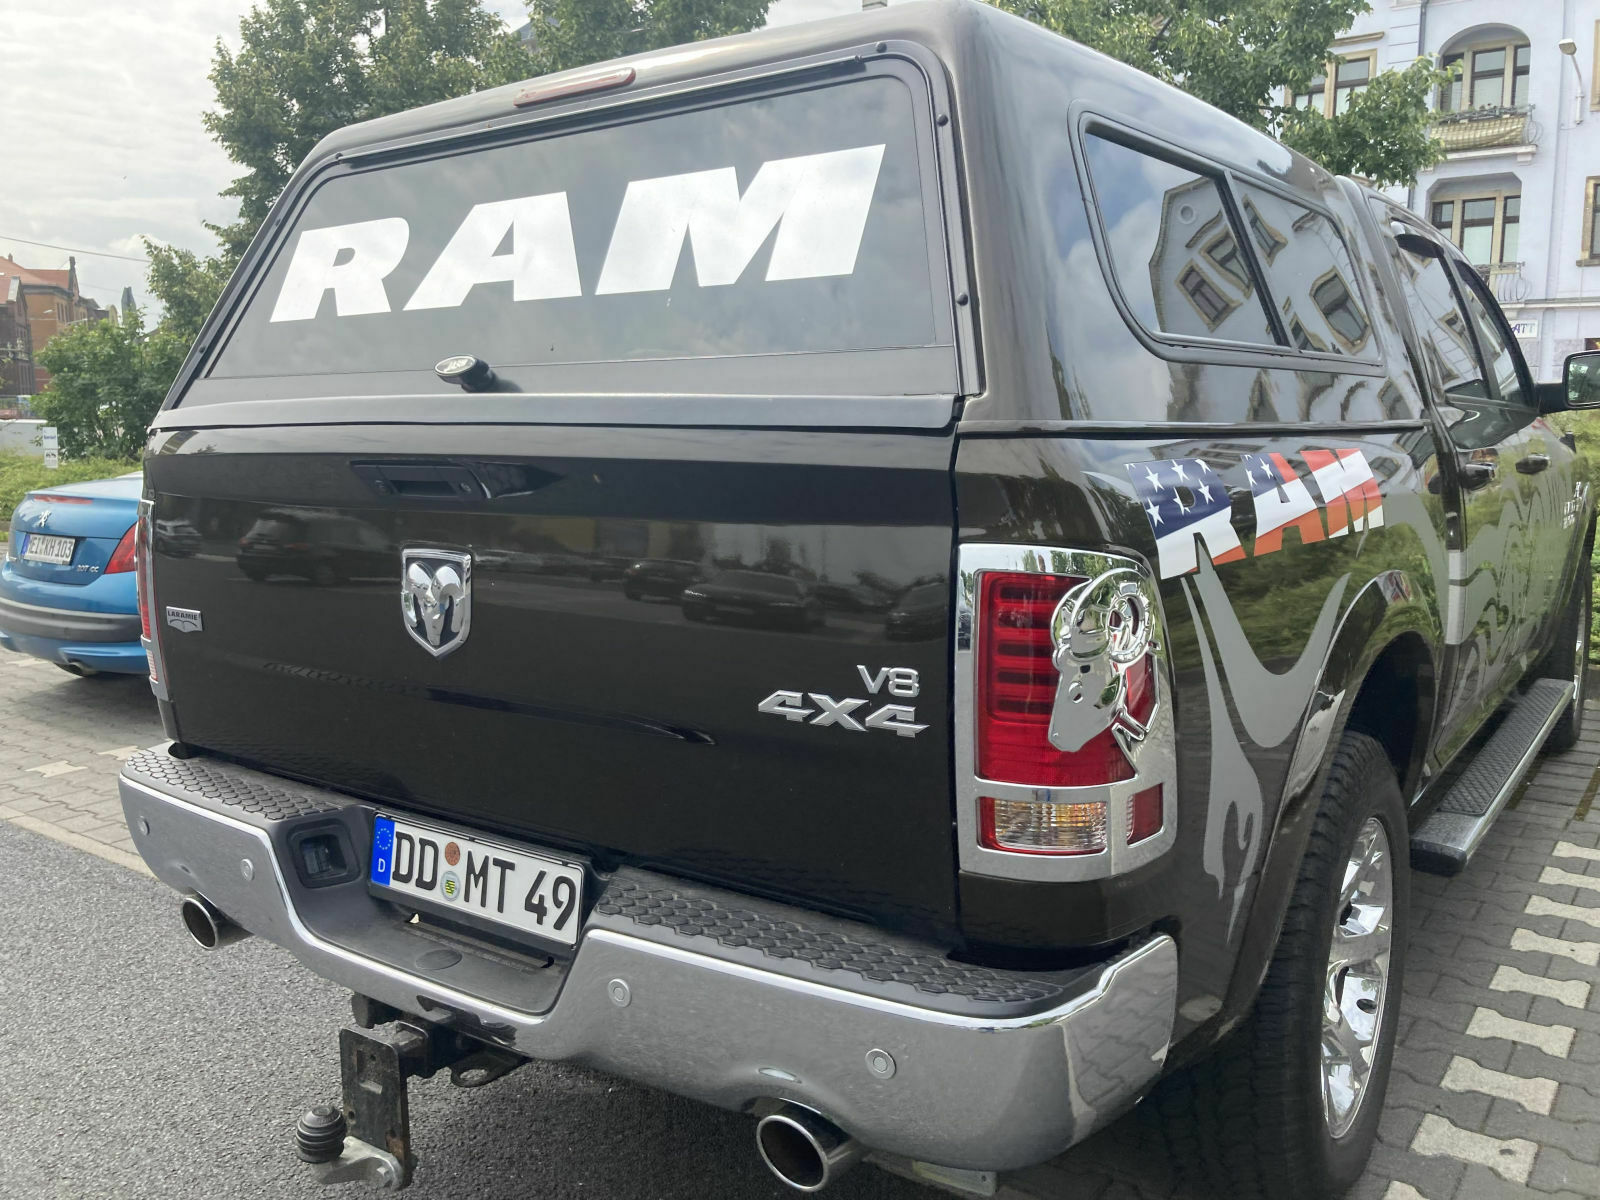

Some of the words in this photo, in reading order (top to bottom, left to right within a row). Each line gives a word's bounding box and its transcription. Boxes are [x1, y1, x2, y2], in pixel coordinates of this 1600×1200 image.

[269, 143, 887, 323] RAM
[1124, 448, 1384, 580] RAM
[55, 539, 73, 559] 103
[167, 610, 198, 620] LARAMIE
[857, 664, 920, 698] V8
[378, 858, 386, 873] D
[392, 831, 440, 891] DD
[463, 850, 516, 914] MT
[525, 870, 577, 931] 49
